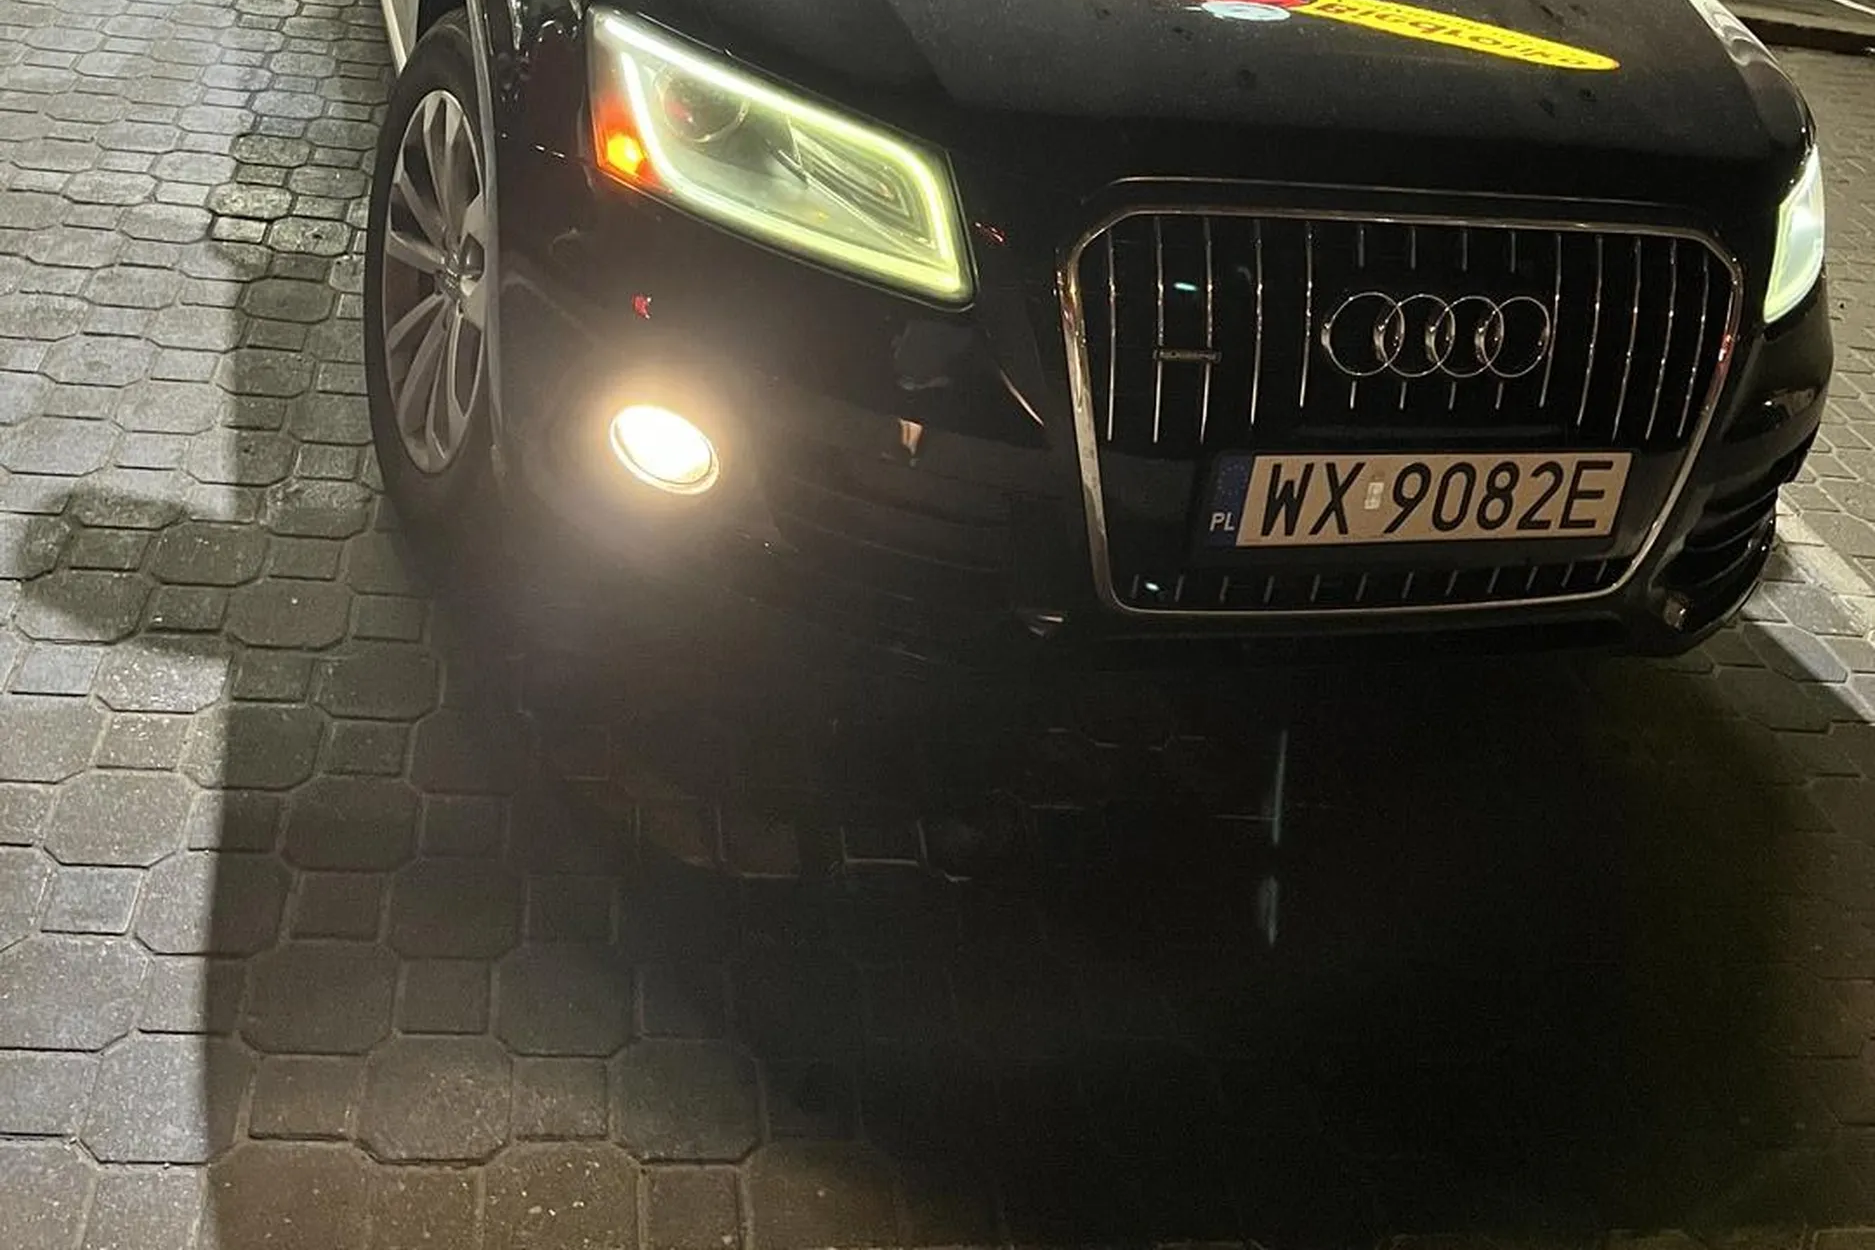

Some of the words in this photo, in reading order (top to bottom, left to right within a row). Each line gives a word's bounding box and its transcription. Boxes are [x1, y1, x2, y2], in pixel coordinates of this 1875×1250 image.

[1210, 511, 1236, 532] PL
[1260, 461, 1366, 537] WX
[1384, 460, 1614, 534] 9082E
